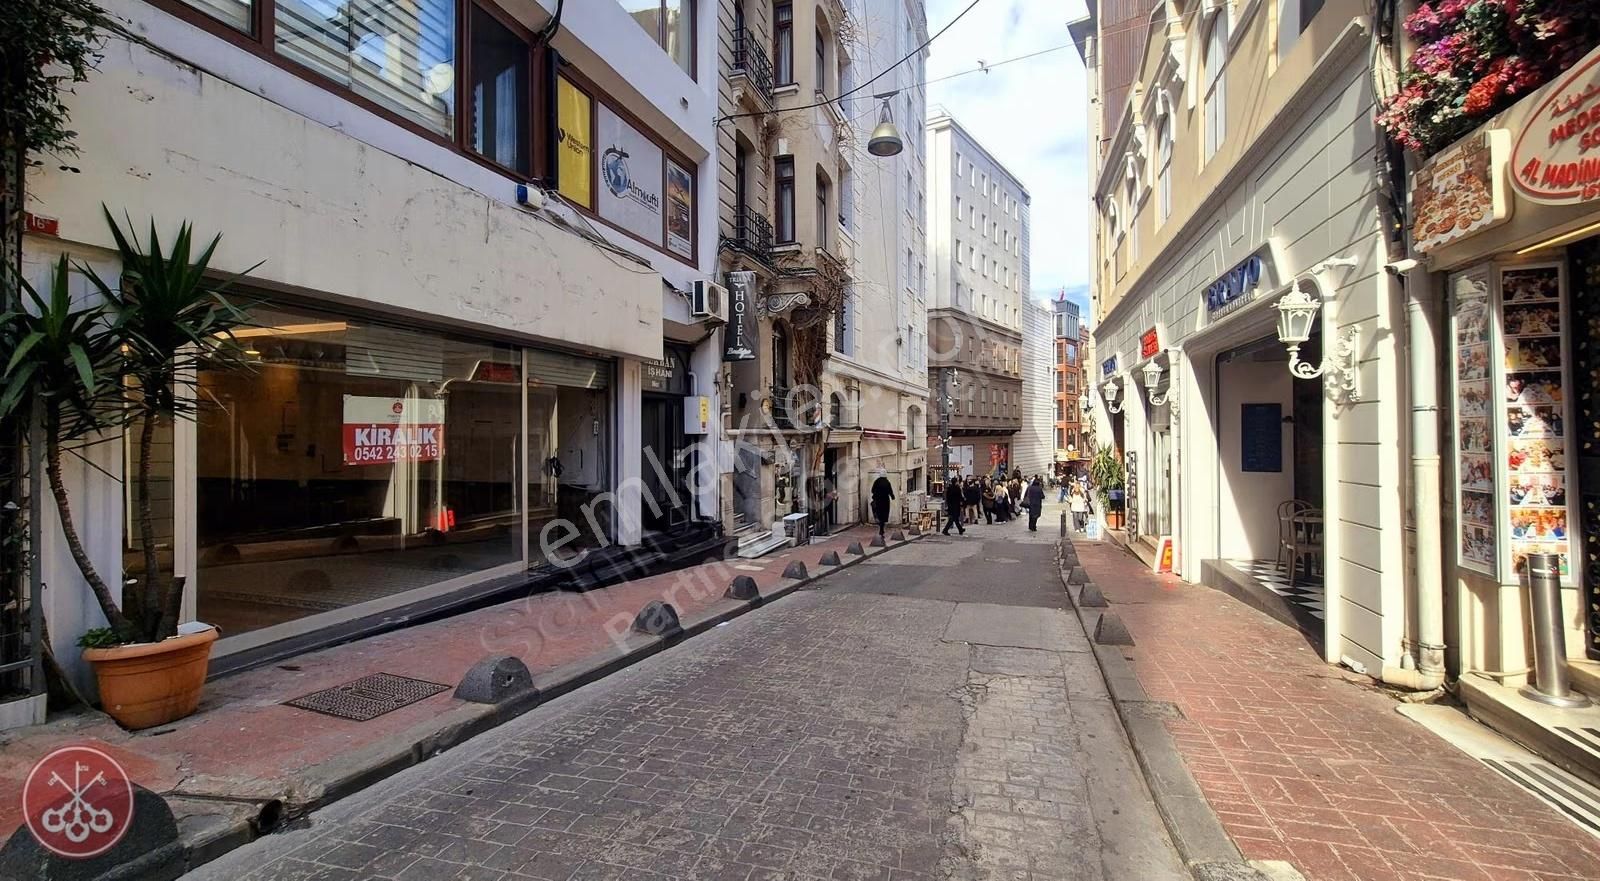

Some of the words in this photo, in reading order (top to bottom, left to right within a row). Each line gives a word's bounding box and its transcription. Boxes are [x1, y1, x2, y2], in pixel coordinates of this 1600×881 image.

[735, 290, 745, 347] HOTEL
[355, 424, 437, 445] KİRALIK
[354, 447, 383, 460] 0542
[386, 445, 407, 460] 243
[410, 444, 422, 458] 02
[425, 444, 438, 457] 15
